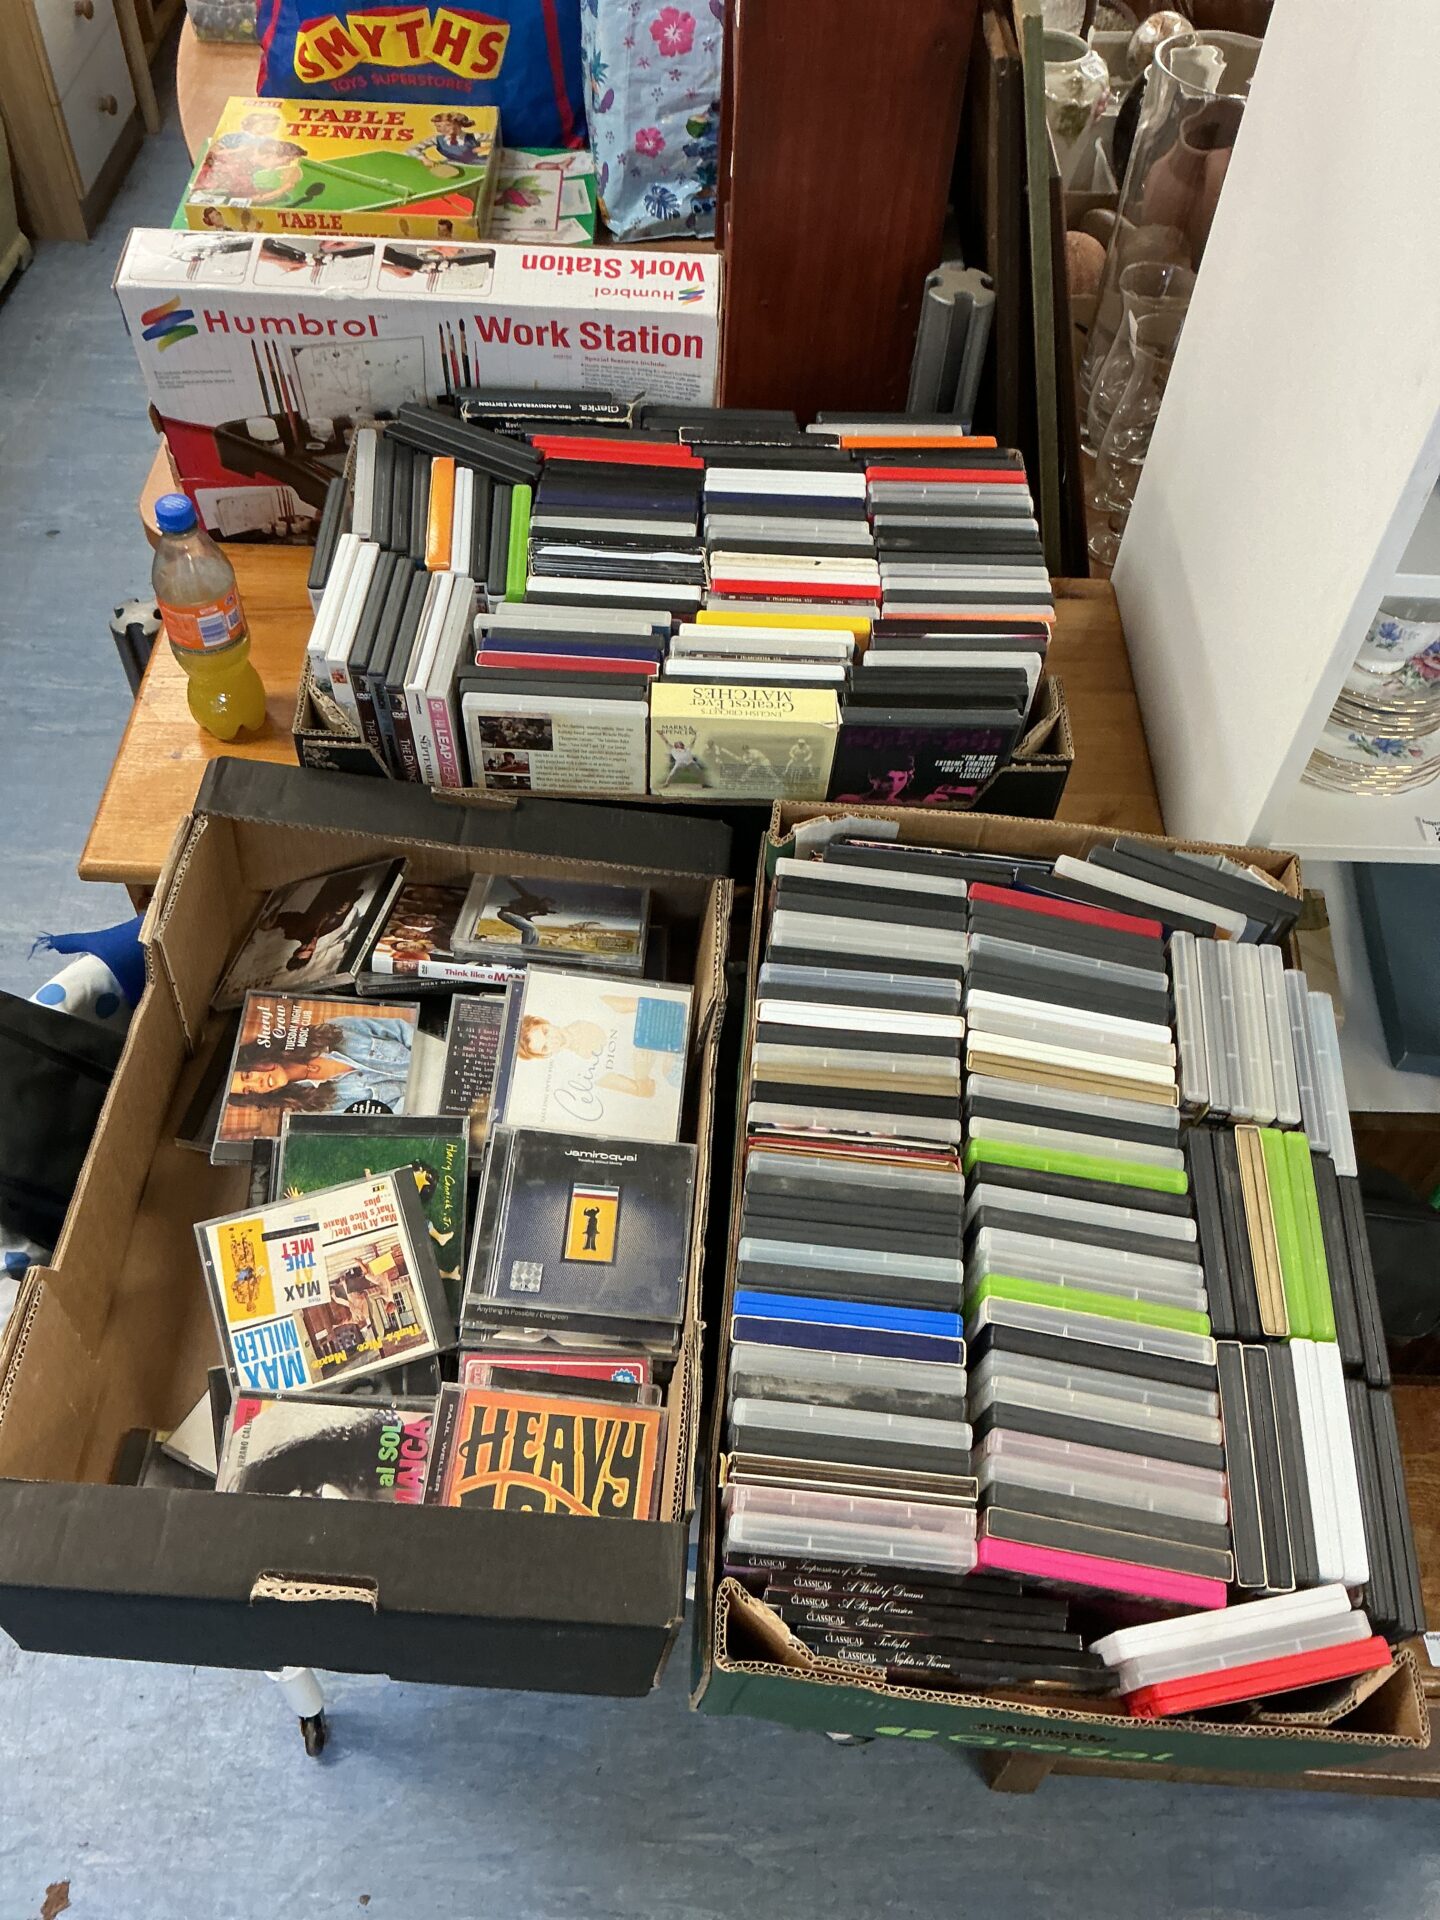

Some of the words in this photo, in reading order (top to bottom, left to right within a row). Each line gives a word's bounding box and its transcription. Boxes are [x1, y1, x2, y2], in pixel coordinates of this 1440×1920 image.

[299, 18, 505, 79] SMYTHS
[331, 74, 368, 93] TOYS
[370, 72, 473, 93] SUPERSTORES
[299, 107, 406, 126] TABLE
[286, 123, 415, 142] TENNIS
[277, 212, 343, 230] TABLE
[521, 254, 622, 279] Station
[631, 260, 705, 282] Work
[594, 287, 674, 301] Humbrol
[203, 309, 378, 337] Humbrol
[474, 315, 571, 349] Work
[579, 321, 703, 359] Station
[478, 400, 508, 408] EDITION
[689, 698, 725, 710] Ever
[692, 687, 793, 702] MATCHES
[730, 699, 794, 713] Greatest
[744, 708, 782, 718] ENGLISH
[400, 739, 411, 755] THE
[436, 728, 452, 760] LEAP
[445, 968, 468, 977] Think
[470, 969, 486, 979] like
[272, 1004, 287, 1039] Crow
[291, 1004, 302, 1025] NIGHT
[302, 1010, 313, 1027] CLUB
[257, 1005, 273, 1049] Sheryl
[285, 1025, 299, 1051] TUESDAY
[297, 1027, 309, 1048] MUSIC
[606, 1028, 619, 1071] DION
[441, 1143, 458, 1171] Harry
[564, 1149, 638, 1162] Jamiroquai
[348, 1209, 368, 1221] Nice
[369, 1203, 396, 1217] That's
[383, 1213, 398, 1224] Max
[323, 1216, 348, 1230] Maxie
[352, 1220, 368, 1232] The
[373, 1217, 383, 1227] At
[281, 1237, 315, 1259] MET
[286, 1252, 317, 1272] THE
[284, 1280, 321, 1302] MAX
[477, 1306, 504, 1316] Anything
[510, 1308, 535, 1318] Possible
[539, 1312, 570, 1321] Evergreen
[233, 1319, 300, 1363] MILLER
[356, 1336, 383, 1353] Nice
[310, 1350, 348, 1369] Maxie
[243, 1350, 307, 1390] MAX
[442, 1403, 454, 1436] PAUL
[378, 1420, 403, 1463] SOL
[237, 1439, 249, 1468] VERANO
[461, 1405, 646, 1518] HEAVY
[433, 1441, 449, 1493] WELLER
[376, 1467, 396, 1488] al
[749, 1556, 787, 1569] CLASSICAL
[796, 1560, 841, 1577] Impressions
[793, 1577, 832, 1590] CLASSICAL
[842, 1581, 858, 1592] A
[859, 1583, 881, 1596] World
[881, 1586, 891, 1598] of
[891, 1584, 924, 1600] Dreams
[791, 1594, 829, 1608] CLASSICAL
[838, 1598, 853, 1609] A
[854, 1599, 882, 1613] Royal
[883, 1600, 914, 1614] Occasion
[806, 1611, 845, 1626] CLASSICAL
[855, 1615, 884, 1629] Passion
[825, 1632, 864, 1646] CLASSICAL
[874, 1634, 910, 1650] Twilight
[837, 1649, 877, 1662] CLASSICAL
[886, 1652, 915, 1666] Nights
[925, 1654, 951, 1669] Vienna
